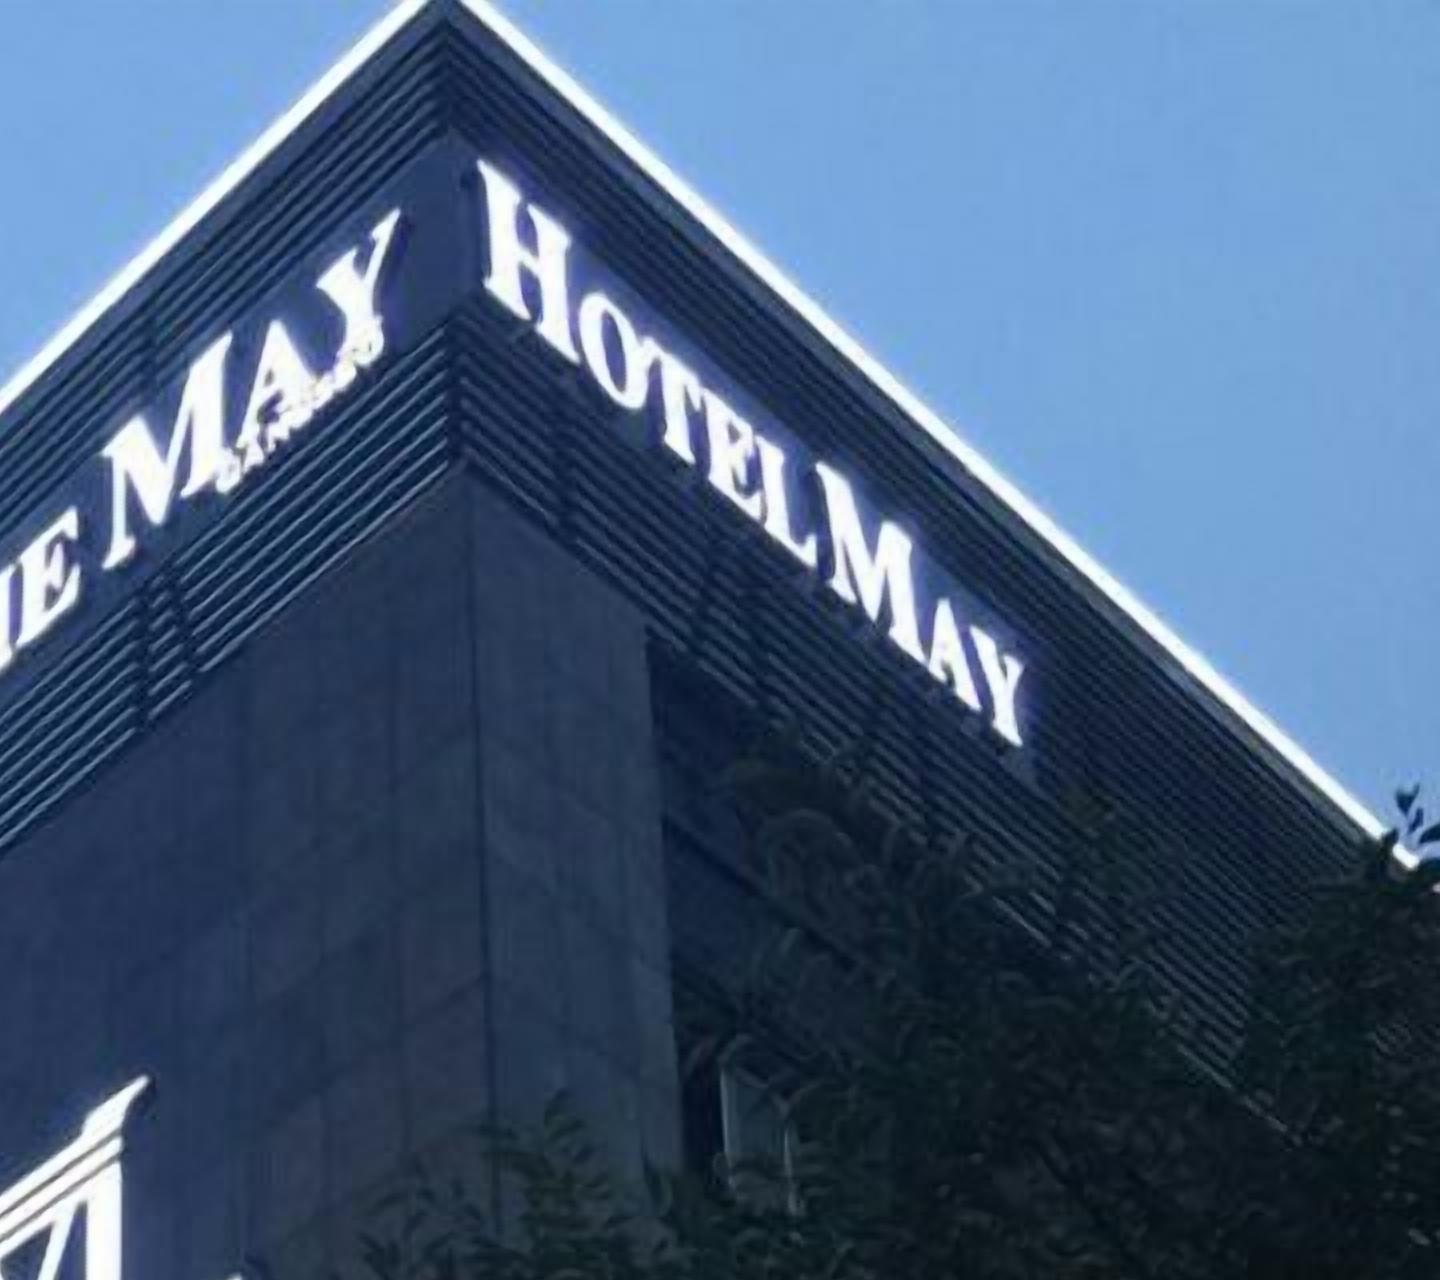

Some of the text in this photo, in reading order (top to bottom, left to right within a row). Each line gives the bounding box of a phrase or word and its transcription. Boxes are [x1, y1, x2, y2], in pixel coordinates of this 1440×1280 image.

[101, 209, 400, 569] MAY
[476, 160, 817, 567] HOTEL
[815, 462, 1023, 746] MAY
